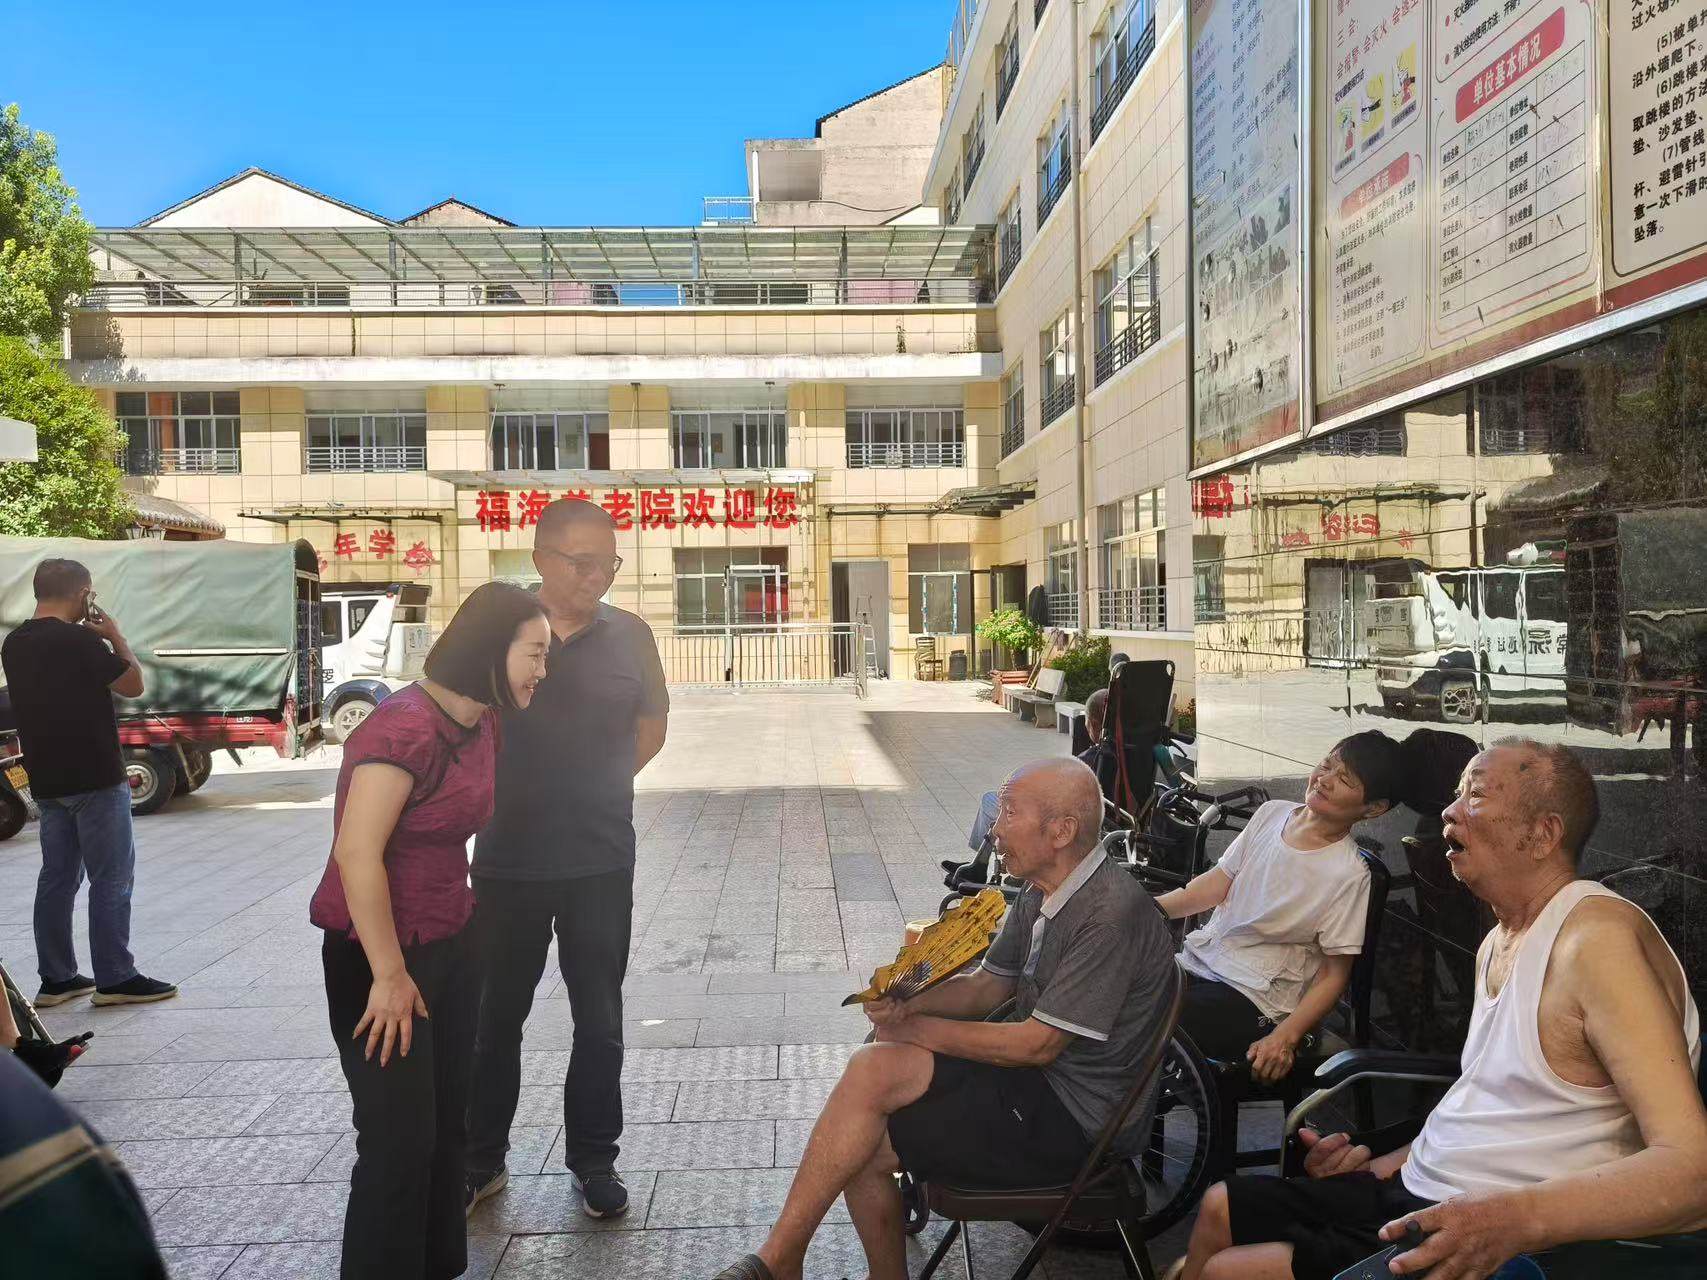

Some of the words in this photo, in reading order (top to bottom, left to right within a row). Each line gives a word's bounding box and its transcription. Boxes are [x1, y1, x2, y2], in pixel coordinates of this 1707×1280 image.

[1473, 32, 1541, 104] 单位基本情况
[1632, 39, 1703, 89] 沿外墙爬下。
[1662, 128, 1705, 162] (7)管线
[1634, 220, 1664, 243] 坠落。
[476, 487, 799, 532] 福海老院欢迎您
